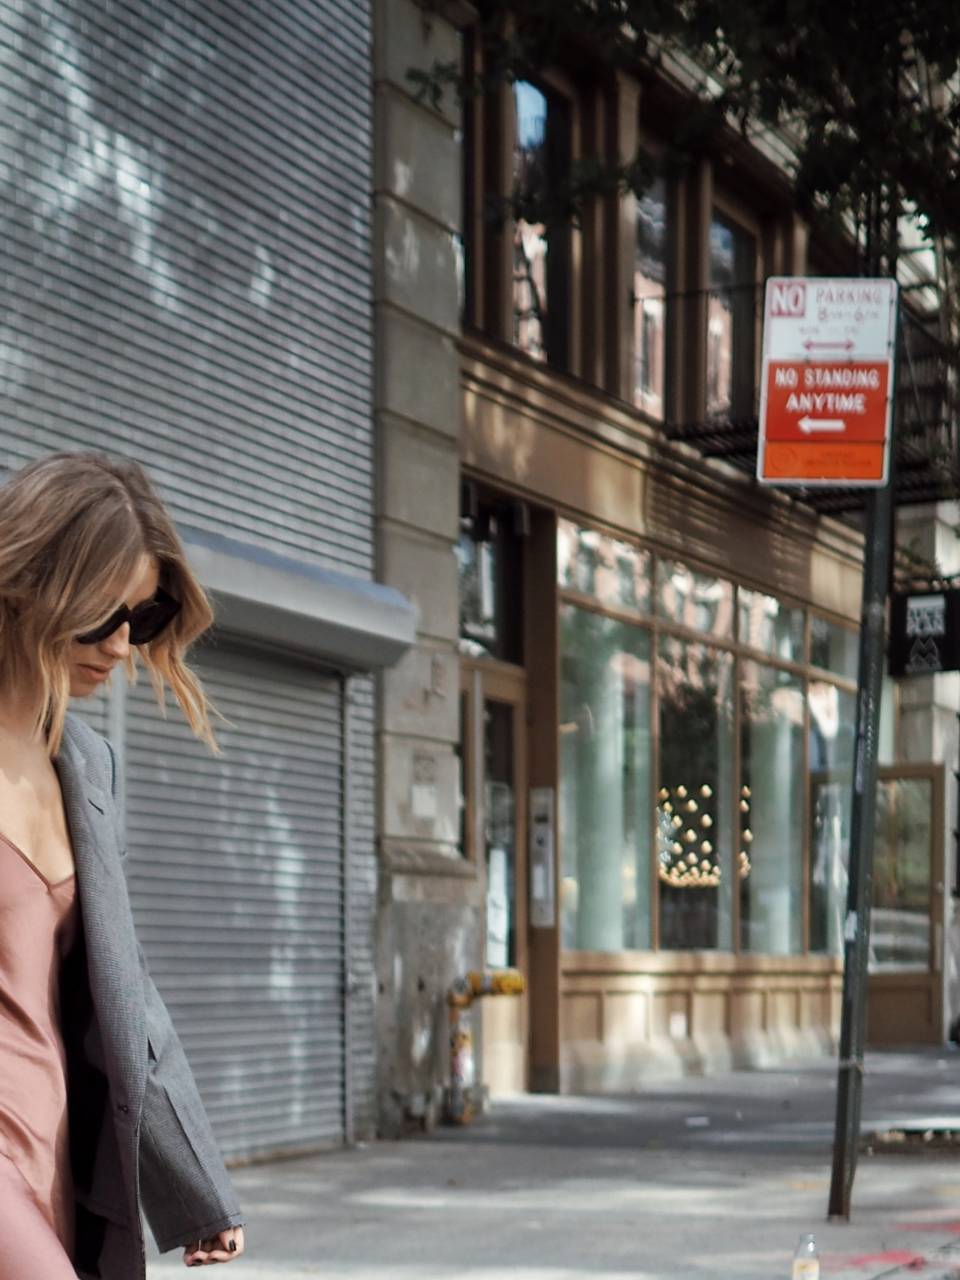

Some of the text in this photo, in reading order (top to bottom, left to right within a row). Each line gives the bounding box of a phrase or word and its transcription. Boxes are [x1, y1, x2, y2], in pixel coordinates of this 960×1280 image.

[771, 285, 883, 315] NO PARKING
[775, 368, 879, 388] NO STANDING
[786, 393, 865, 412] ANYTIME
